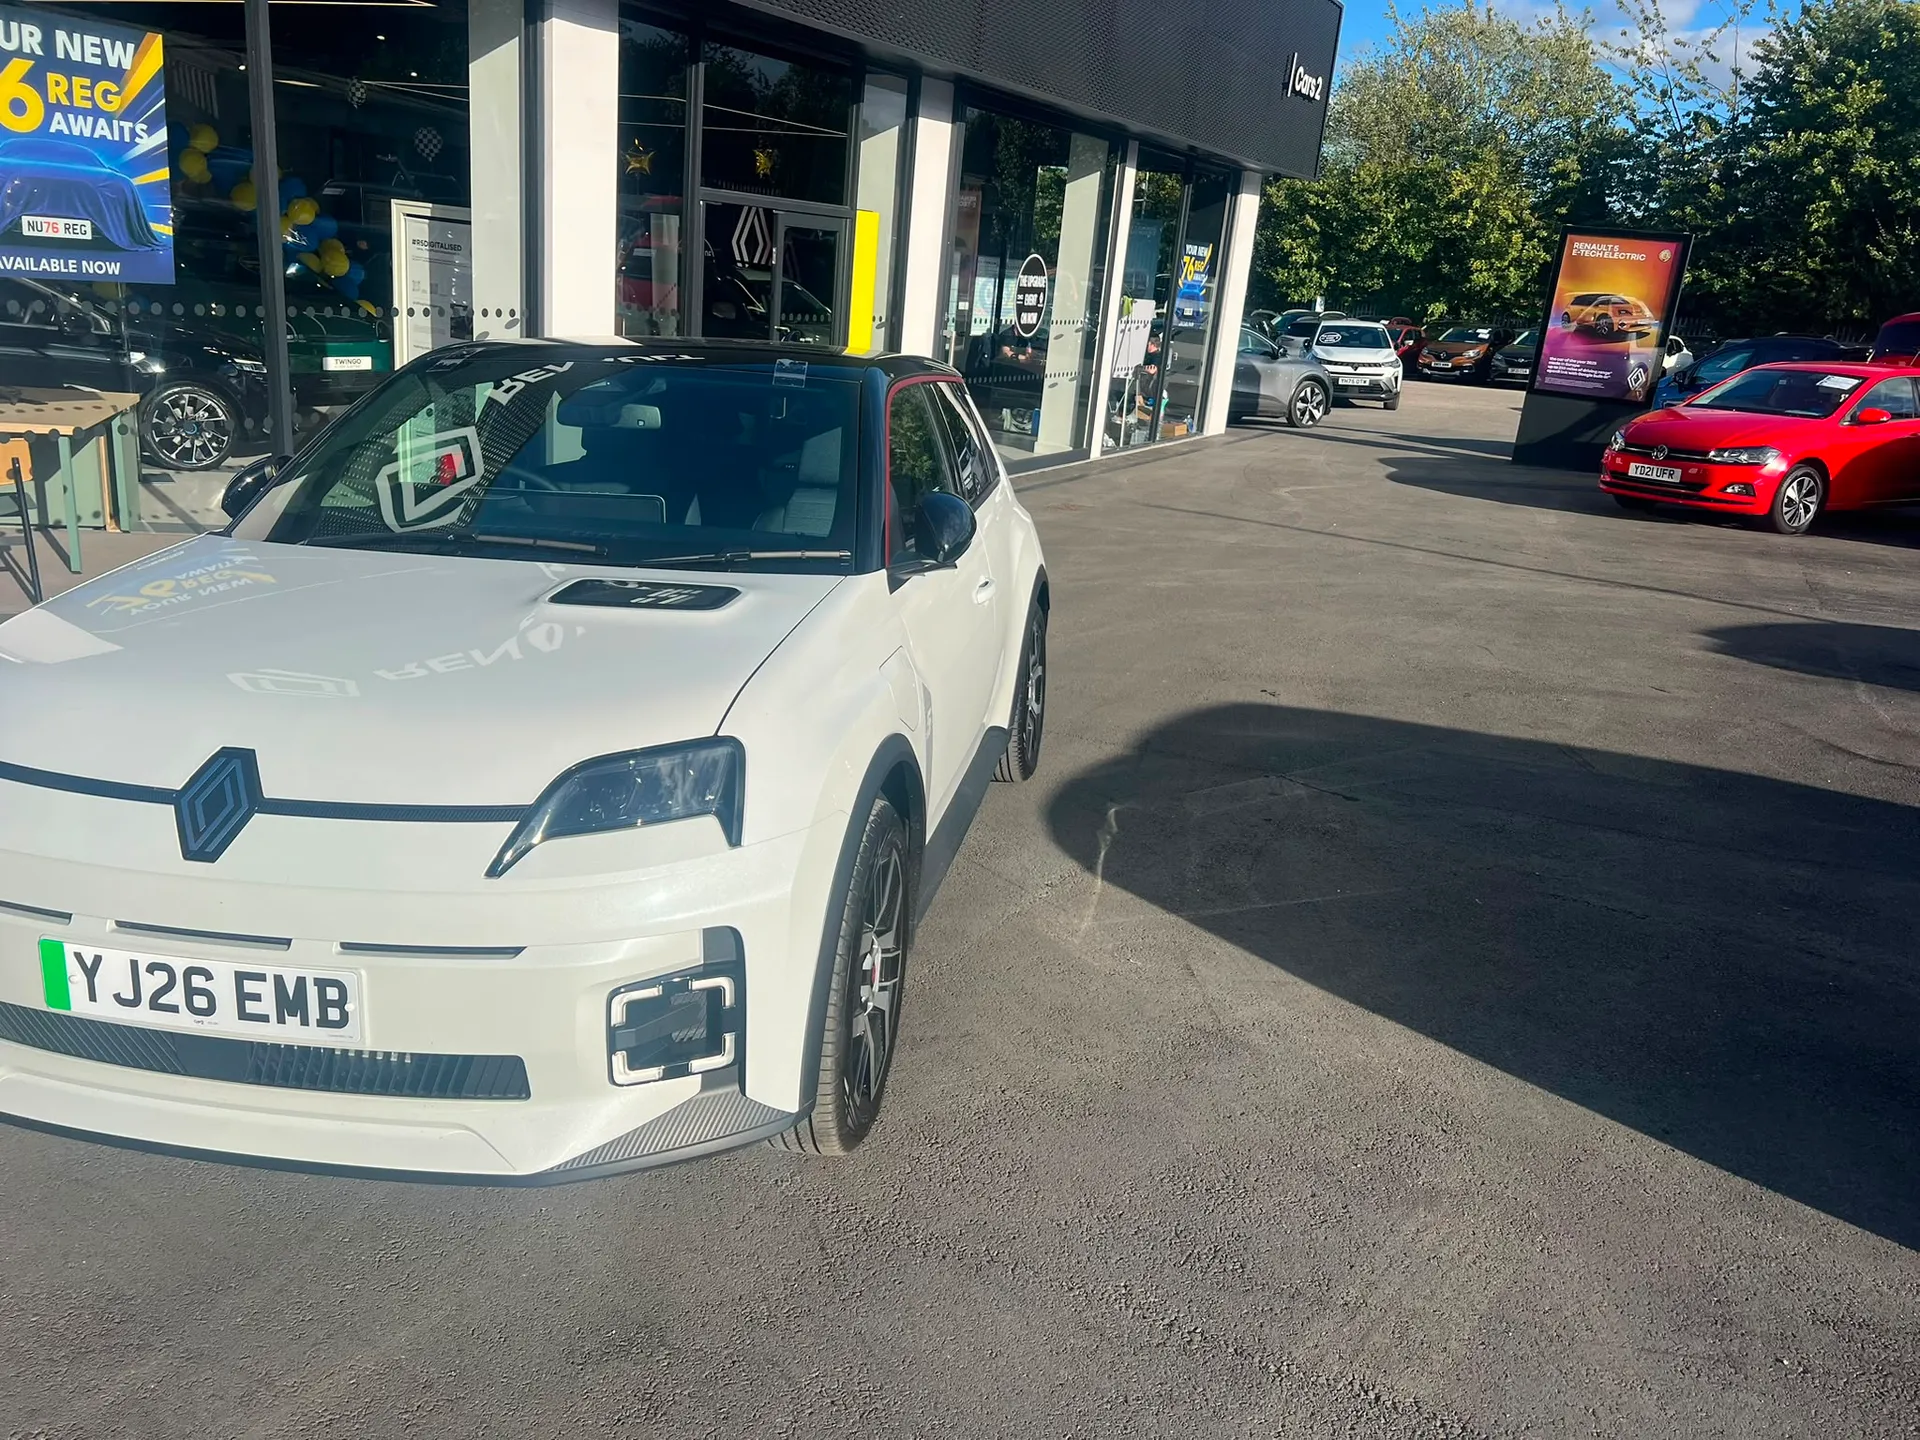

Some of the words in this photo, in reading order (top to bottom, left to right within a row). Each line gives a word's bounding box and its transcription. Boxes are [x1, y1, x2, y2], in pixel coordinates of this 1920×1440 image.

[54, 29, 135, 70] NEW
[1295, 66, 1316, 98] Cars
[1314, 76, 1323, 101] 2
[46, 72, 122, 112] REG
[49, 111, 149, 145] AWAITS
[27, 220, 60, 233] NU76
[63, 223, 87, 236] REG
[1185, 244, 1198, 256] YOUR
[1197, 246, 1209, 258] NEW
[1573, 241, 1613, 252] RENAULT
[1613, 244, 1620, 252] 5
[1571, 249, 1605, 258] E-TECH
[1604, 250, 1647, 261] ELECTRIC
[82, 260, 121, 275] NOW
[1181, 255, 1195, 281] 76
[1026, 275, 1047, 288] UPGRADE
[1634, 464, 1655, 477] YD21
[1655, 467, 1675, 480] UFR
[72, 951, 217, 1018] YJ26
[233, 969, 349, 1030] EMB
